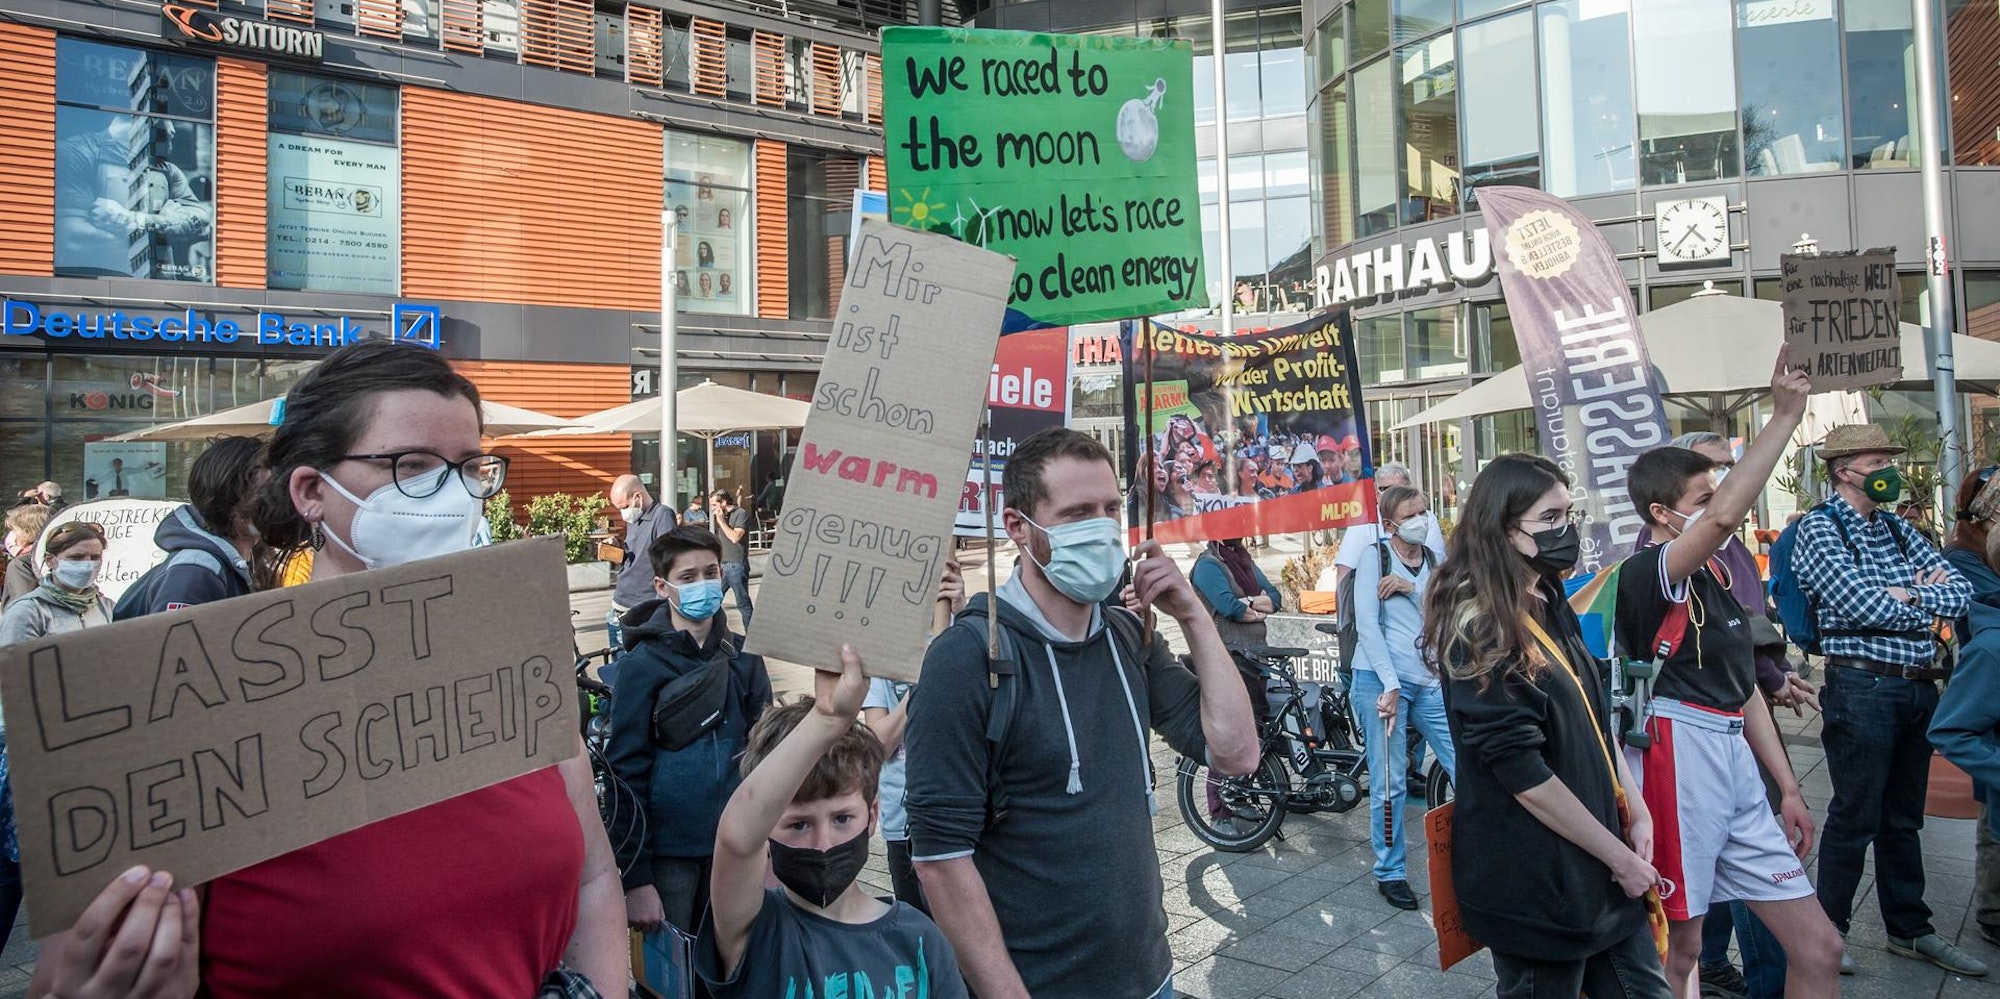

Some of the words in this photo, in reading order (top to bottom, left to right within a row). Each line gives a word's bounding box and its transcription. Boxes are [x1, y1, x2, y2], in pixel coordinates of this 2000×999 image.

[221, 17, 324, 57] SATURN
[82, 54, 201, 92] BEAN
[982, 46, 1062, 97] raced
[1068, 49, 1108, 97] to
[288, 144, 321, 154] DREAM
[901, 115, 983, 172] the
[996, 130, 1101, 169] moon
[333, 160, 363, 168] EVERY
[366, 163, 386, 171] MAN
[997, 204, 1053, 241] now
[1060, 192, 1118, 237] let's
[1125, 197, 1184, 232] race
[305, 236, 329, 245] 0214
[339, 239, 362, 248] 7500
[365, 241, 389, 249] 4590
[850, 234, 942, 305] Mir
[1007, 271, 1033, 304] o
[1040, 252, 1115, 299] clean
[1121, 255, 1198, 301] energy
[1316, 228, 1498, 308] RATHAU
[1784, 262, 1799, 277] für
[1810, 269, 1861, 293] nachhaltige
[1864, 263, 1896, 292] WELT
[3, 301, 239, 342] Deutsche
[257, 311, 363, 347] Bank
[836, 304, 900, 360] ist
[1257, 321, 1341, 356] Umwelt
[1788, 316, 1807, 335] für
[1807, 298, 1899, 345] FRIEDEN
[1241, 367, 1269, 387] der
[1273, 351, 1346, 382] Profit-
[1816, 346, 1901, 377] ARTENVIELFALT
[815, 366, 934, 434] schon
[989, 364, 1053, 408] iele
[1139, 391, 1188, 413] AARM!
[1230, 382, 1352, 418] Wirtschaft
[972, 437, 1016, 456] mach
[803, 441, 938, 499] warm
[75, 506, 176, 525] KURZSTRECKE
[1320, 501, 1363, 522] MLPD
[95, 560, 140, 583] ekten
[772, 507, 942, 606] genug
[29, 574, 454, 752] LASST
[1312, 658, 1342, 683] BRA
[48, 732, 270, 877] DEN
[300, 654, 563, 800] SCHEIß
[1772, 867, 1805, 885] SPALDIN
